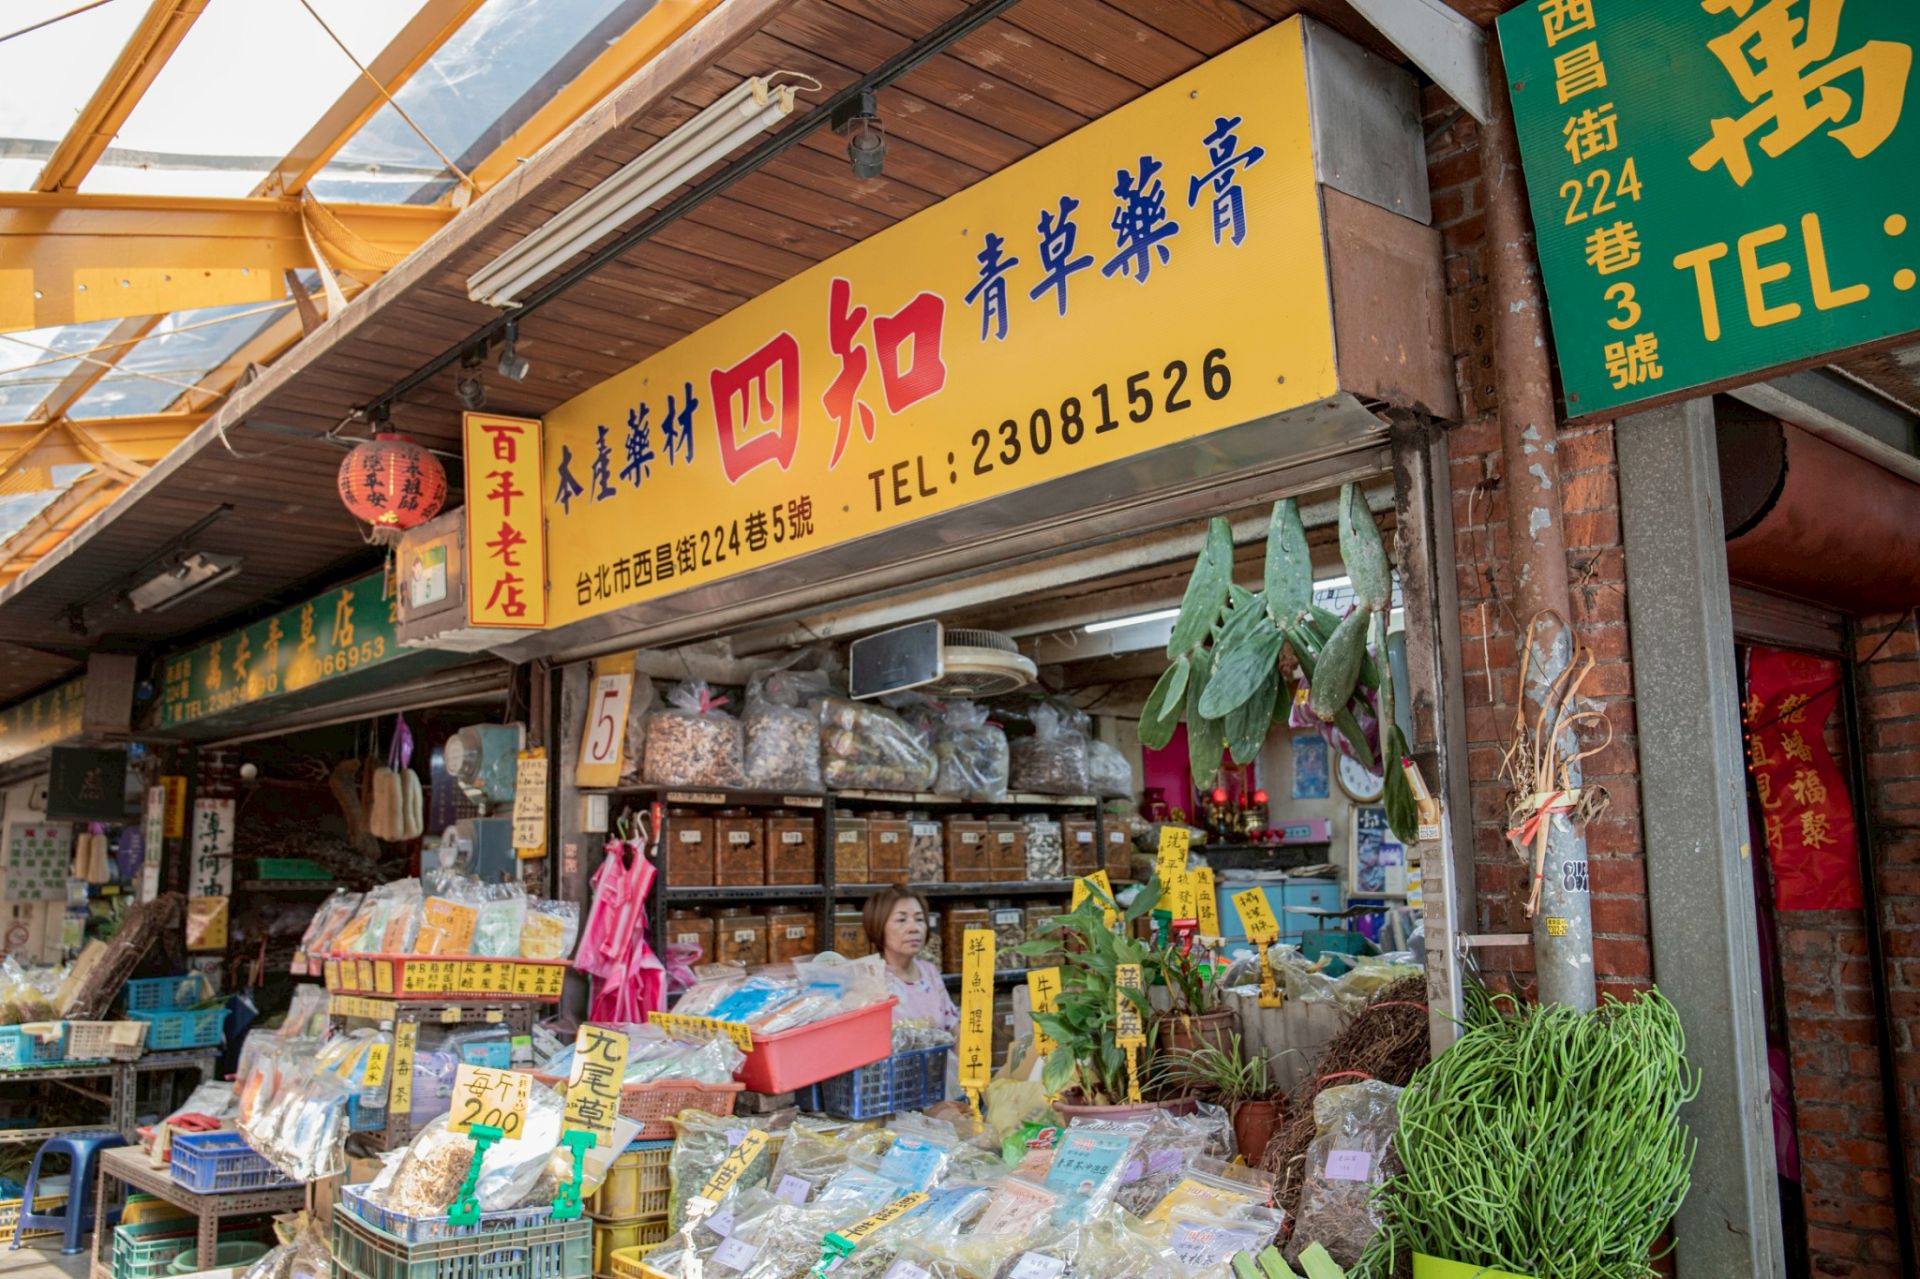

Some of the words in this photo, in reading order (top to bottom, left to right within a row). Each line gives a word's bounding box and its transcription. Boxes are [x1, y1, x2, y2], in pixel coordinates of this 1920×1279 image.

[1687, 0, 1914, 188] 萬
[964, 116, 1266, 343] 青草藥膏
[1538, 0, 1664, 390] 西昌街224巷3號
[1673, 212, 1917, 342] TEL:
[709, 277, 946, 486] 四知
[554, 381, 702, 516] 本產藥材
[481, 423, 529, 619] 百年老店
[575, 494, 815, 607] 台北市西昌街224巷5號
[592, 690, 619, 760] 5
[197, 810, 227, 896] 薄荷油
[966, 936, 987, 1078] 鮮魚腥草
[458, 1098, 519, 1134] 200
[463, 1068, 513, 1102] 每斤
[564, 1030, 622, 1131] 九尾草
[706, 1136, 760, 1199] 艾草
